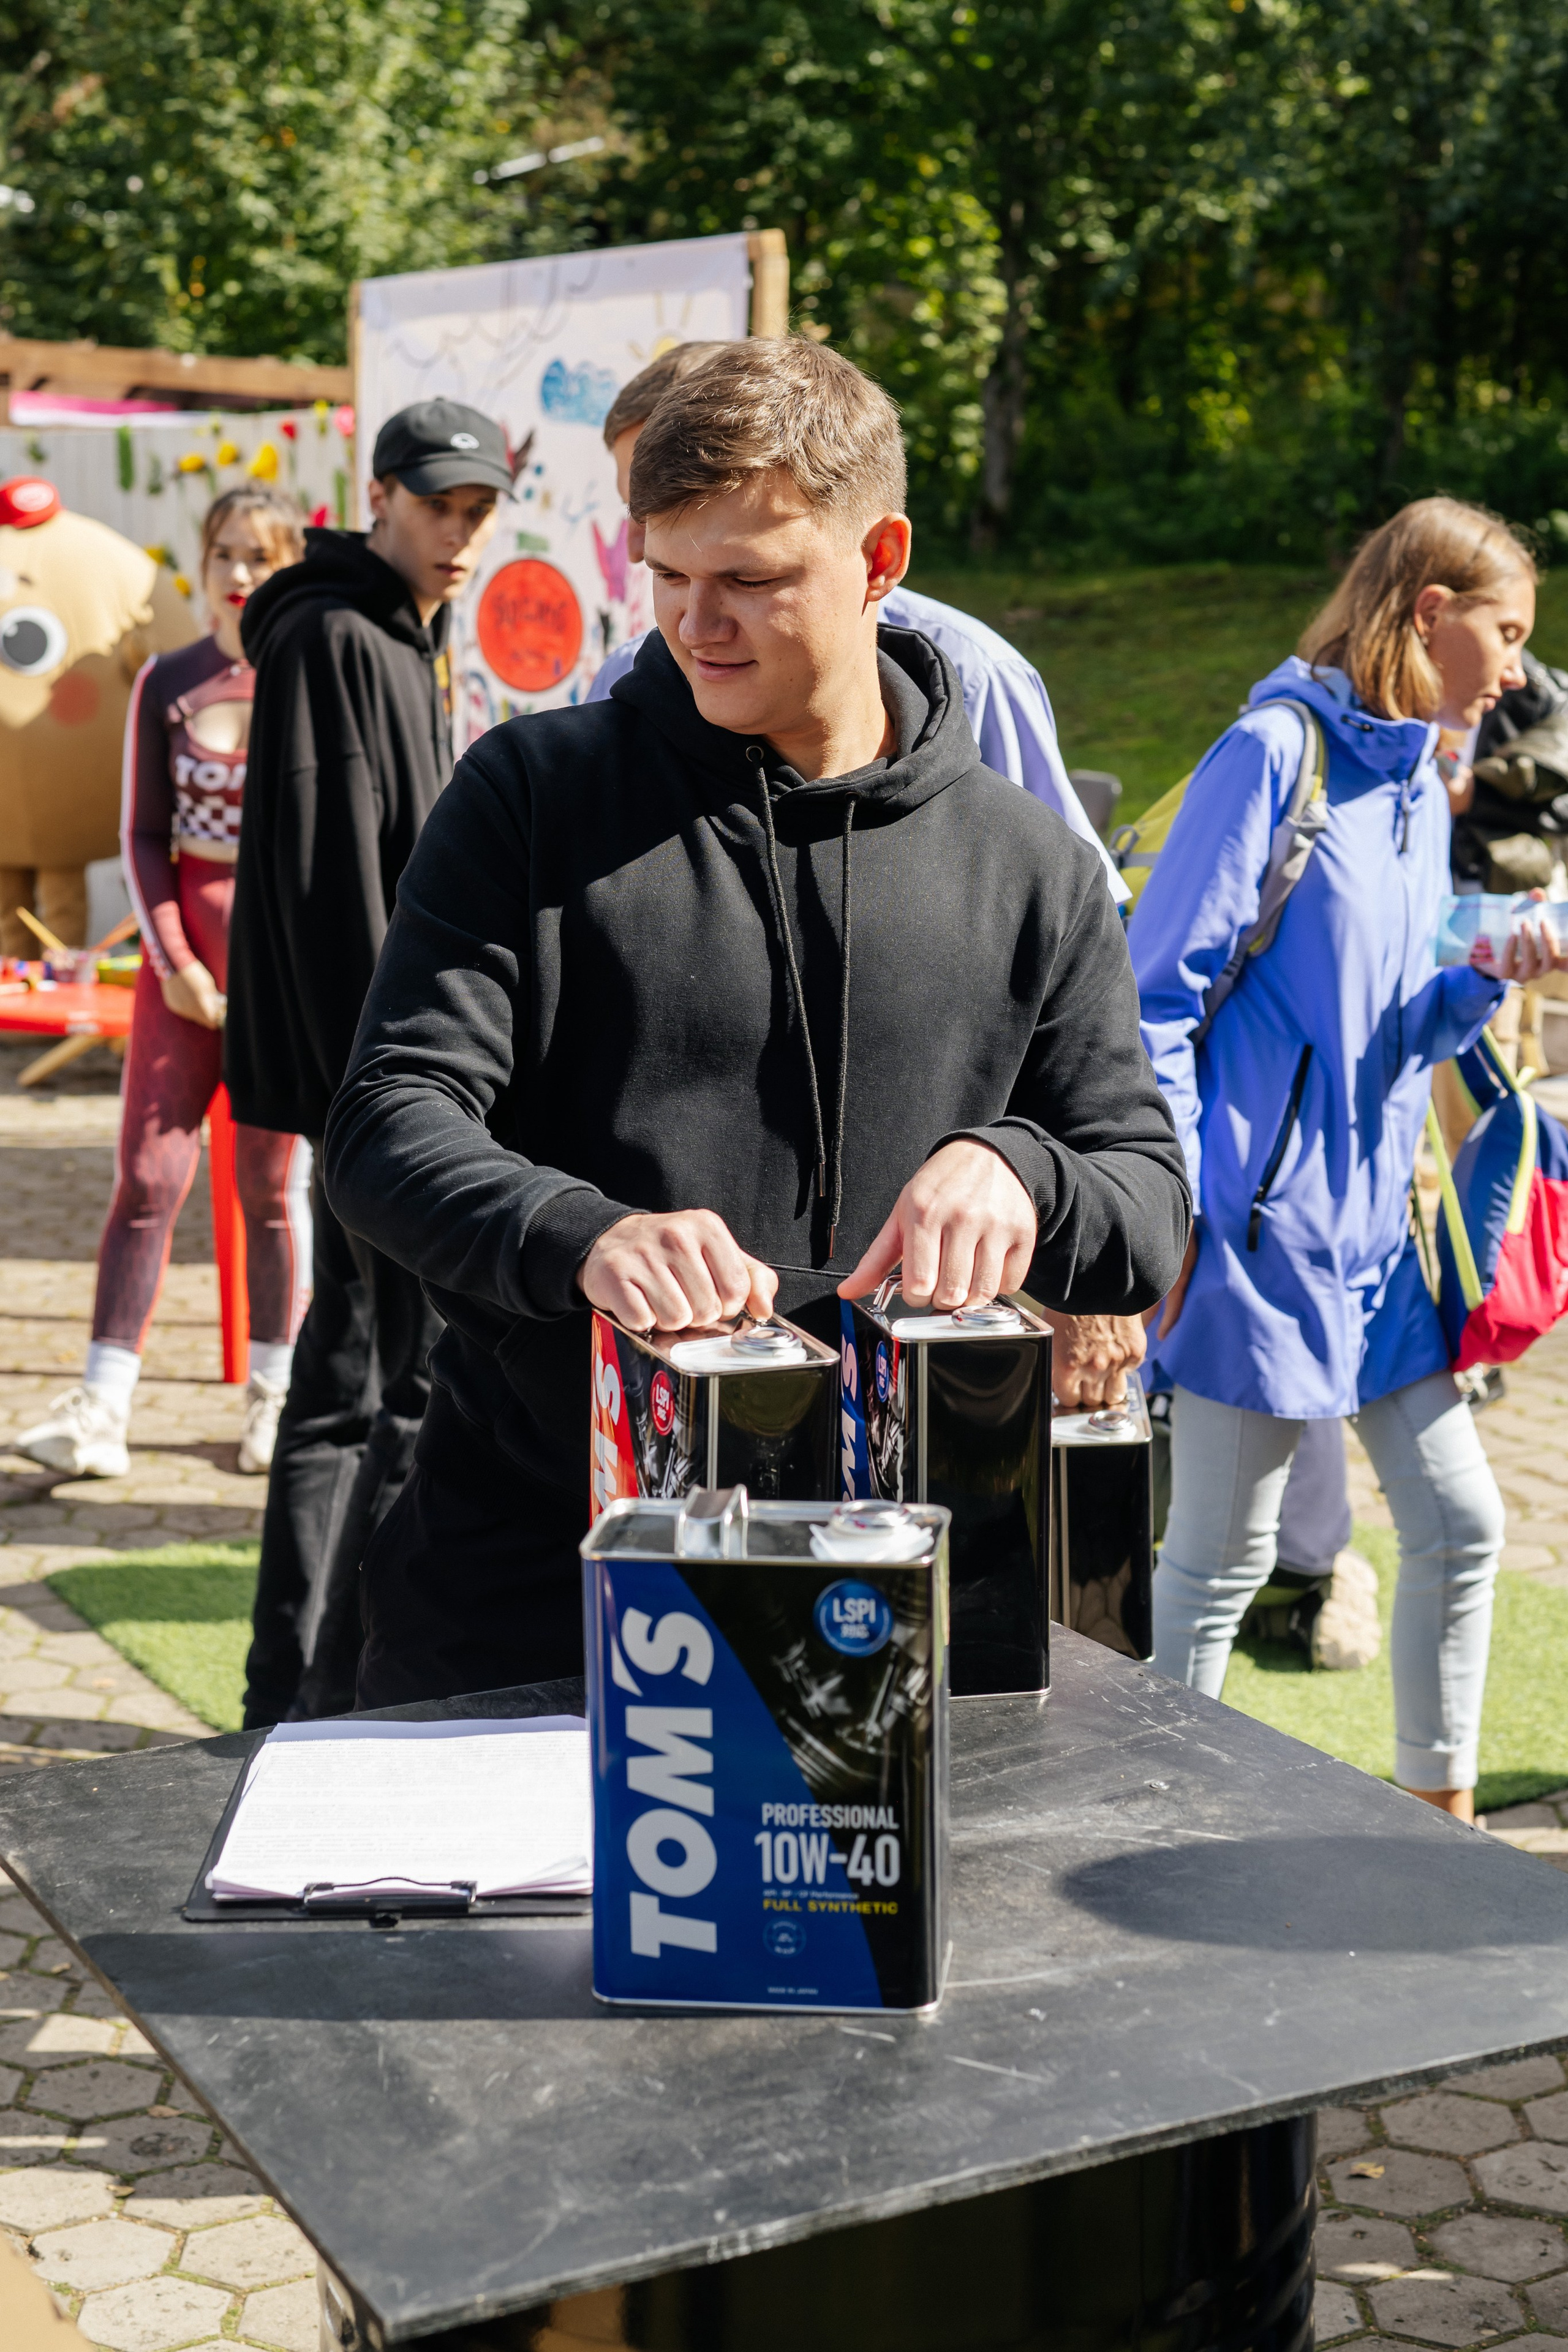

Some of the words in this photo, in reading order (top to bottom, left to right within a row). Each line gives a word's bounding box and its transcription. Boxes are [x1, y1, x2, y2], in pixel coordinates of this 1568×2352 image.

[655, 1384, 669, 1411] LSPI
[832, 1597, 876, 1624] LSPI
[612, 1607, 718, 1958] TOM'S
[761, 1803, 900, 1830] PROFESSIONAL
[755, 1831, 900, 1887] 10W-40
[763, 1900, 802, 1912] FULL
[807, 1900, 899, 1914] SYNTHETIC
